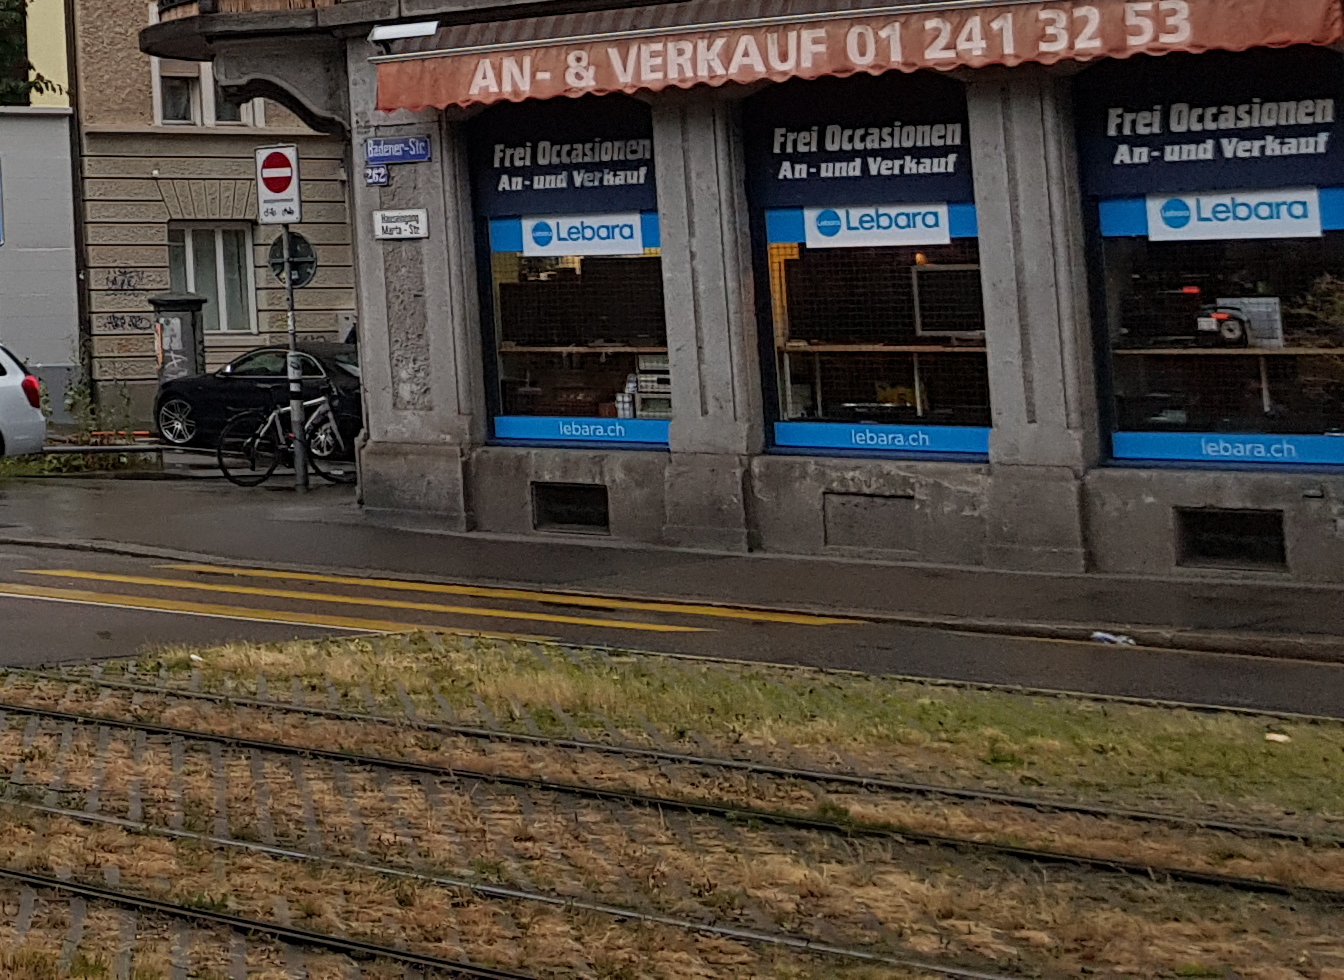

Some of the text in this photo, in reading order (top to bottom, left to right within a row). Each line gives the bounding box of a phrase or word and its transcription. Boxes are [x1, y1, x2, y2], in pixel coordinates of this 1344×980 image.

[468, 0, 1192, 95] AN- & VERKAUF 01 241 32 53
[1107, 98, 1335, 136] Frei Occasionen
[773, 121, 962, 154] Frei Occasionen
[1220, 132, 1331, 158] Verkauf
[493, 138, 651, 168] Frei Occasionen
[867, 153, 958, 176] Verkauf
[366, 167, 386, 183] 262
[572, 166, 647, 188] Verkauf
[846, 208, 940, 231] Lebara
[1196, 197, 1309, 222] Lebara
[381, 225, 402, 235] Marta
[556, 221, 634, 242] Lebara
[559, 421, 625, 437] lebara.ch
[851, 429, 929, 446] lebara.ch
[1201, 438, 1298, 457] lebara.ch
